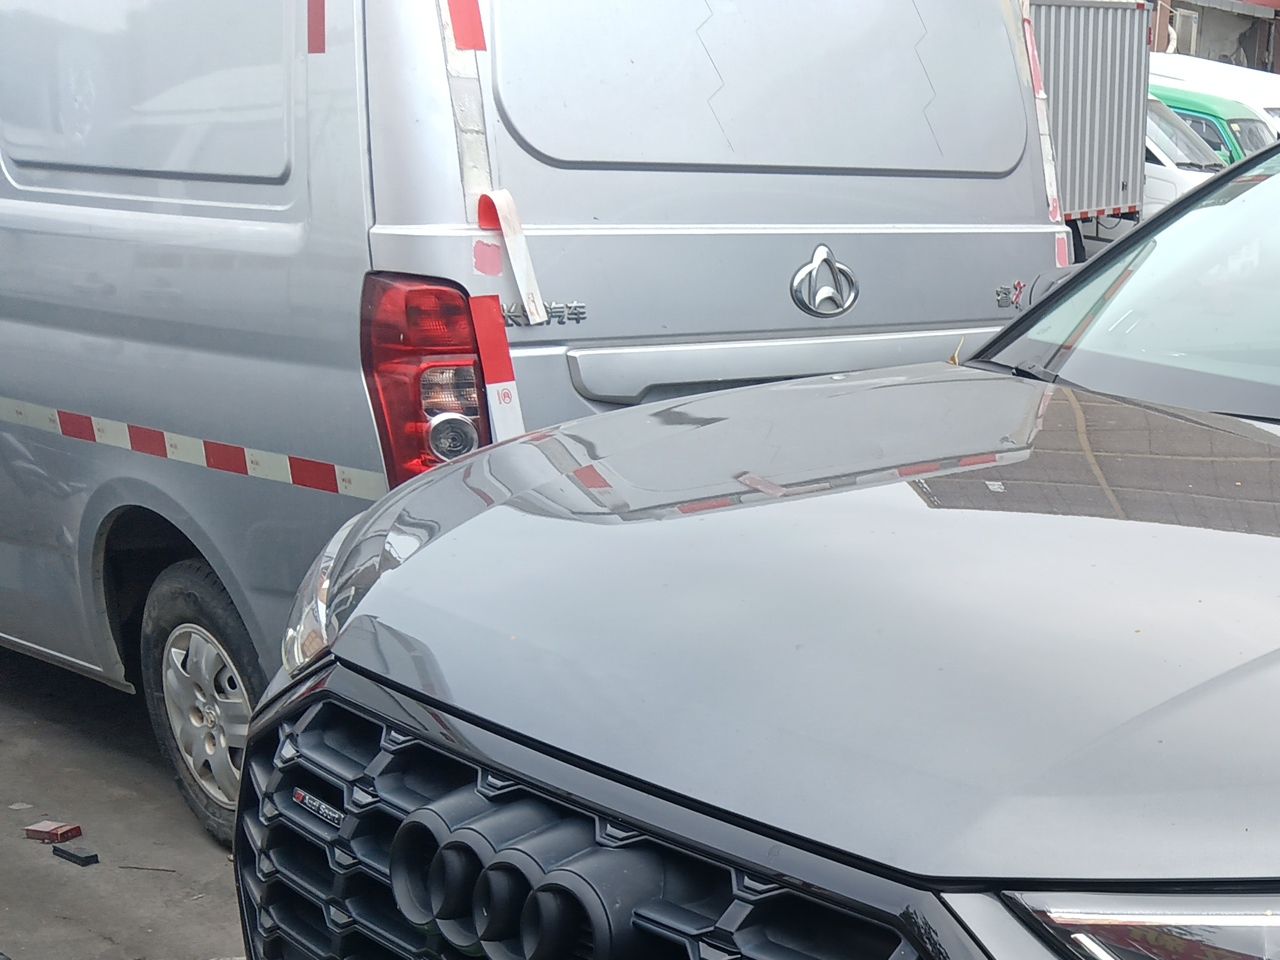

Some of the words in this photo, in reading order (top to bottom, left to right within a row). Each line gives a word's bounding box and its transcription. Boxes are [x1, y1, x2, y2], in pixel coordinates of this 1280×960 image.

[501, 300, 587, 327] 长汽车
[319, 804, 340, 824] Sport
